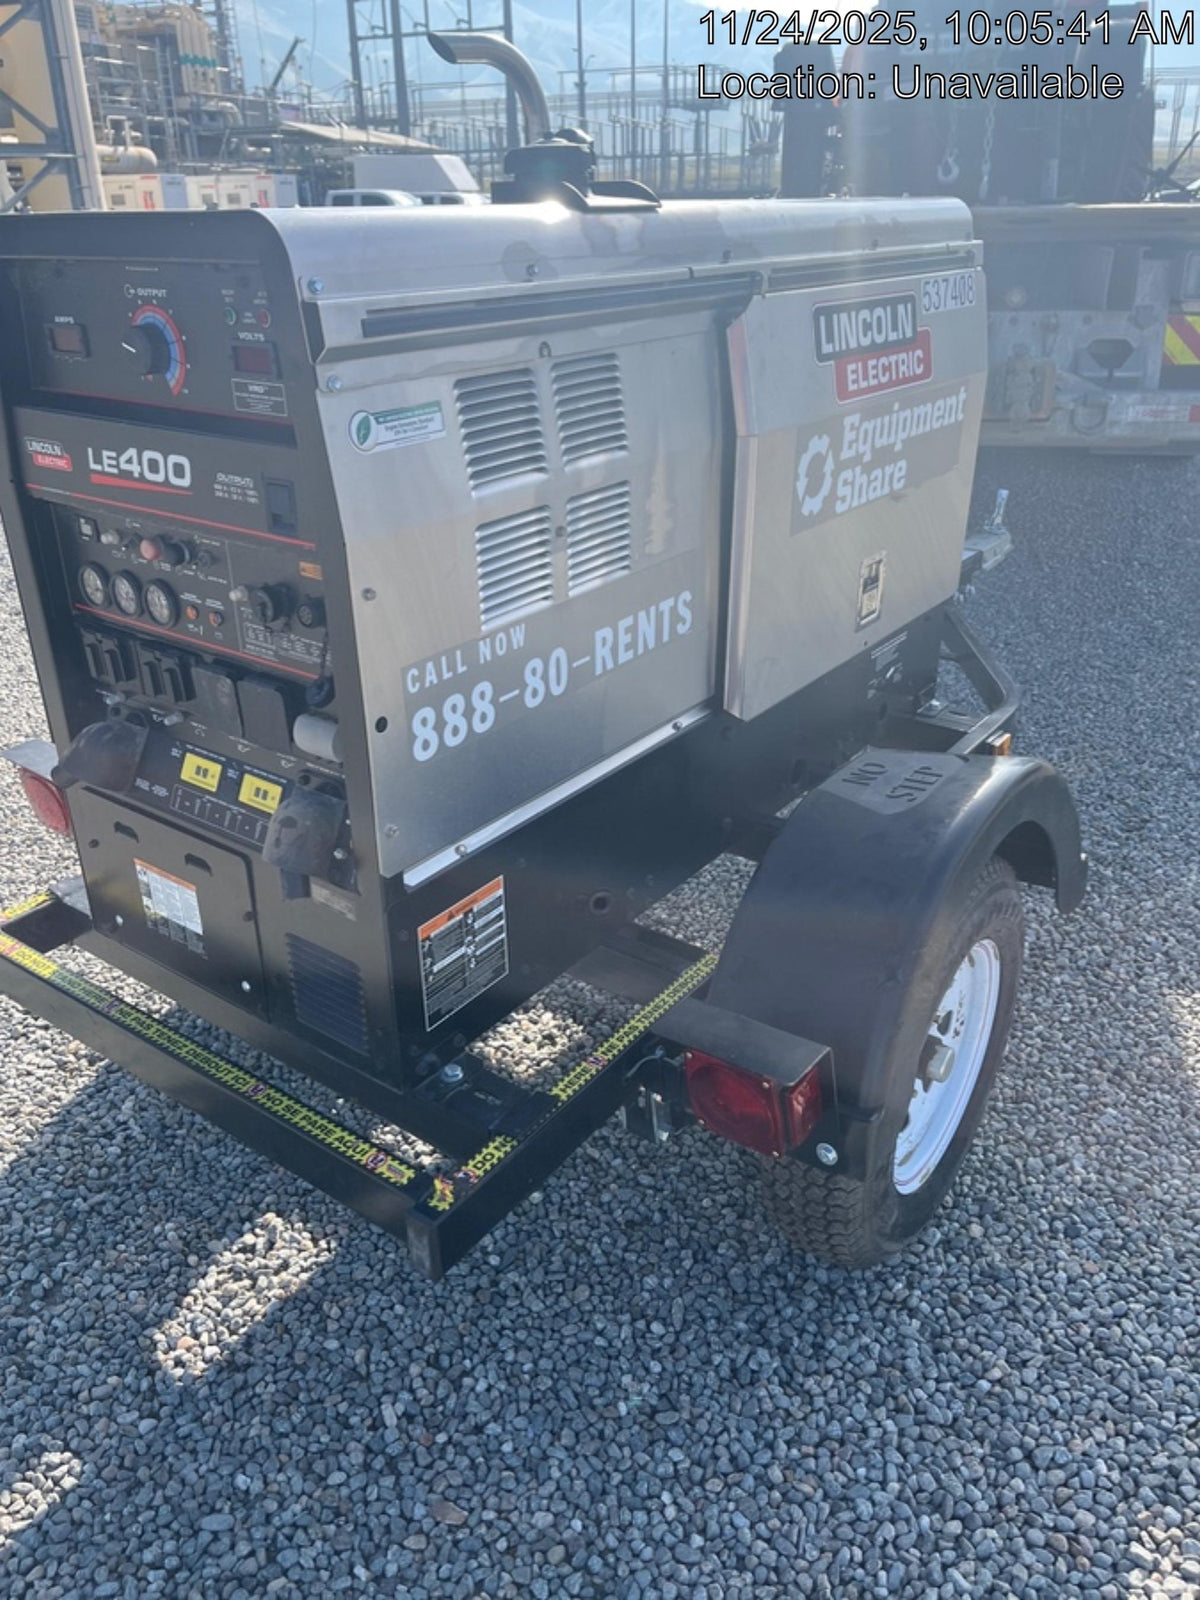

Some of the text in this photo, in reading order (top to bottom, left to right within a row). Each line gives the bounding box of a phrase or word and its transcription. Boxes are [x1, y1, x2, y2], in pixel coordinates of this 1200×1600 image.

[137, 288, 167, 298] OUTPUT
[922, 273, 975, 313] 537408
[238, 332, 266, 342] VOLTS
[819, 302, 913, 355] LINCOLN
[846, 349, 925, 392] ELECTRIC
[840, 386, 967, 464] Equipment
[25, 440, 61, 456] LINCOLN
[87, 447, 192, 488] LE400
[835, 459, 908, 515] Share
[406, 622, 527, 694] CALL NOW
[411, 590, 693, 762] 888-80-RENTS
[842, 762, 888, 787] NO
[885, 765, 944, 803] STEP
[186, 1046, 232, 1076] DEBOUT
[262, 1091, 283, 1107] NO
[282, 1102, 300, 1119] SE
[299, 1113, 336, 1138] PARE
[474, 1152, 495, 1171] DO
